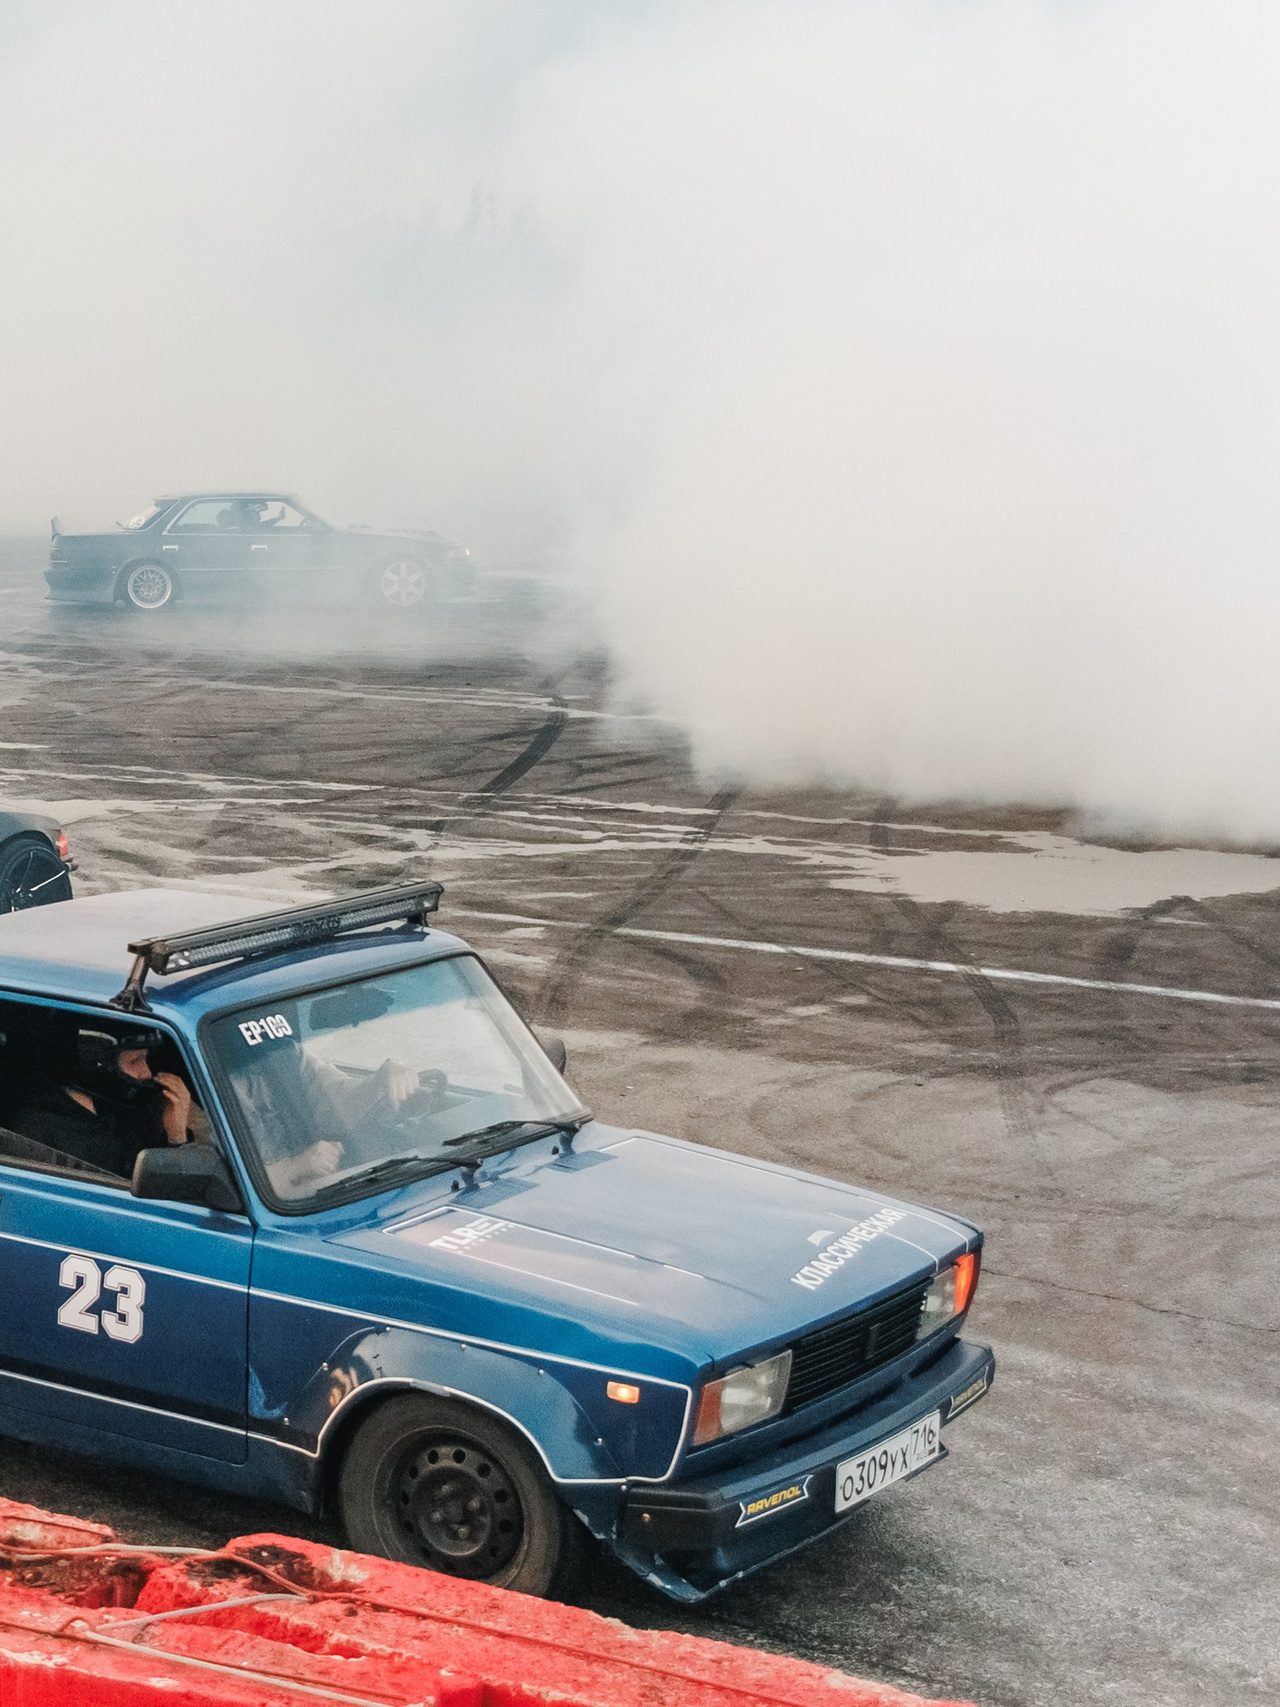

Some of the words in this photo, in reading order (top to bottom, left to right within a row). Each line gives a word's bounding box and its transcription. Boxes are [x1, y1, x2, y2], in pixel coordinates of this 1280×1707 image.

[790, 1208, 907, 1290] КЛАССИЧЕСКАЯ
[57, 1253, 146, 1344] 23
[912, 1420, 935, 1456] 716
[747, 1485, 802, 1515] RAVENOL
